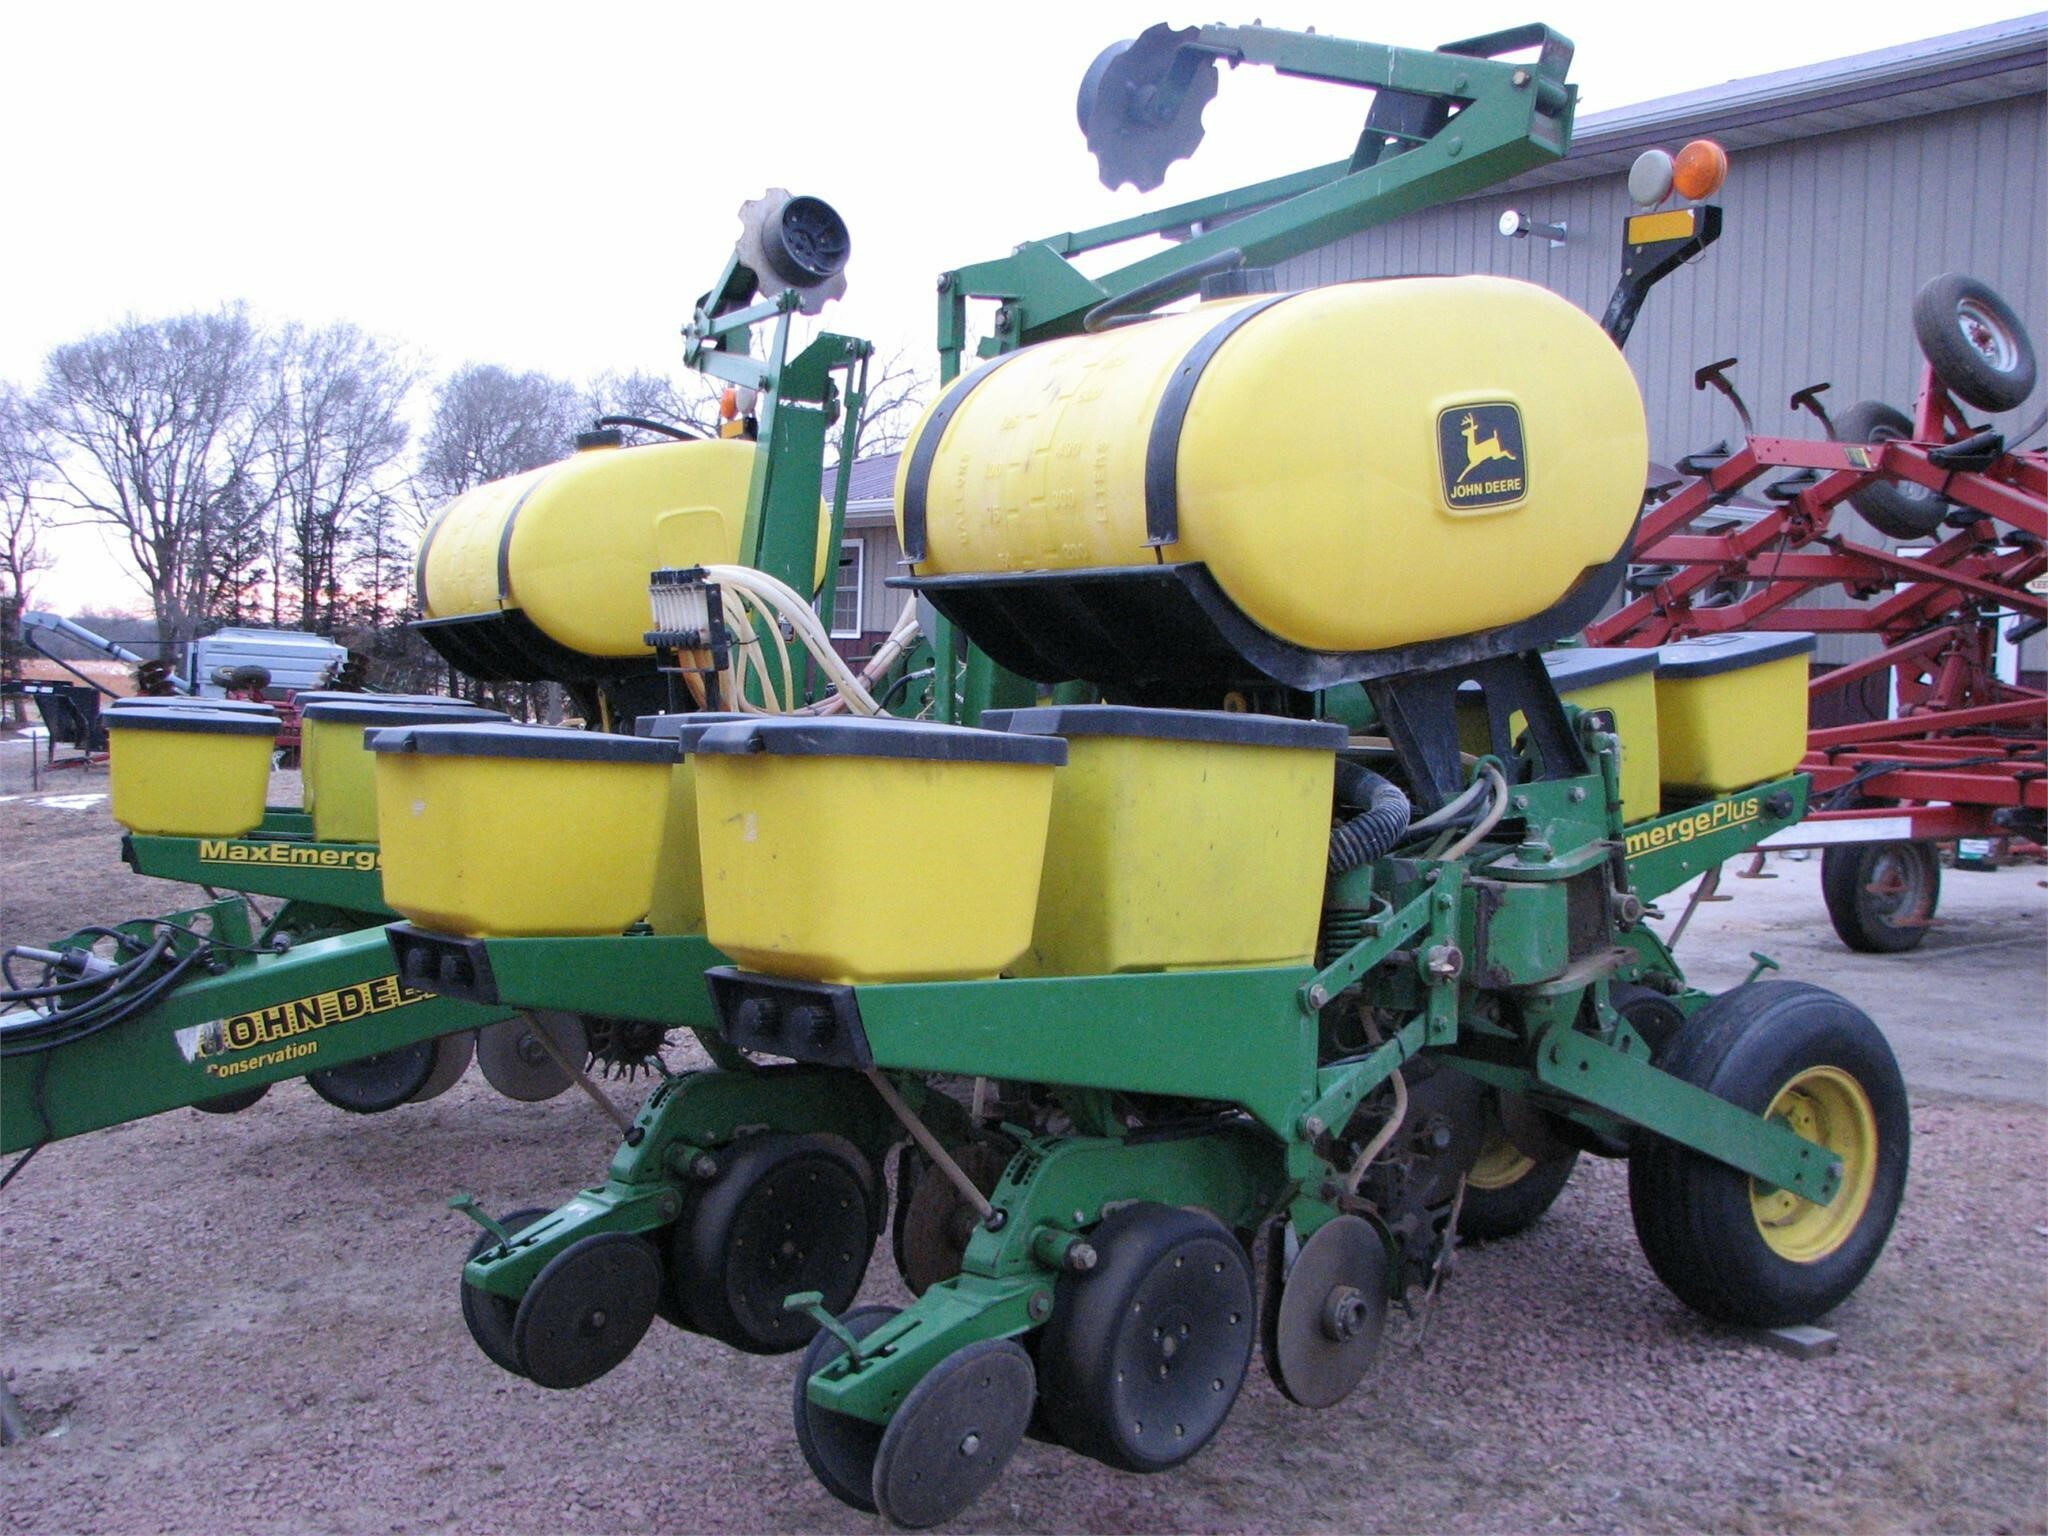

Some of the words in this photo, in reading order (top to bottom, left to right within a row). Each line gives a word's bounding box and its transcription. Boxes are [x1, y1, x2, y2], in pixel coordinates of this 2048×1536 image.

[1450, 483, 1483, 499] JOHN
[1485, 478, 1521, 494] DEERE
[1626, 798, 1759, 854] mergePlus
